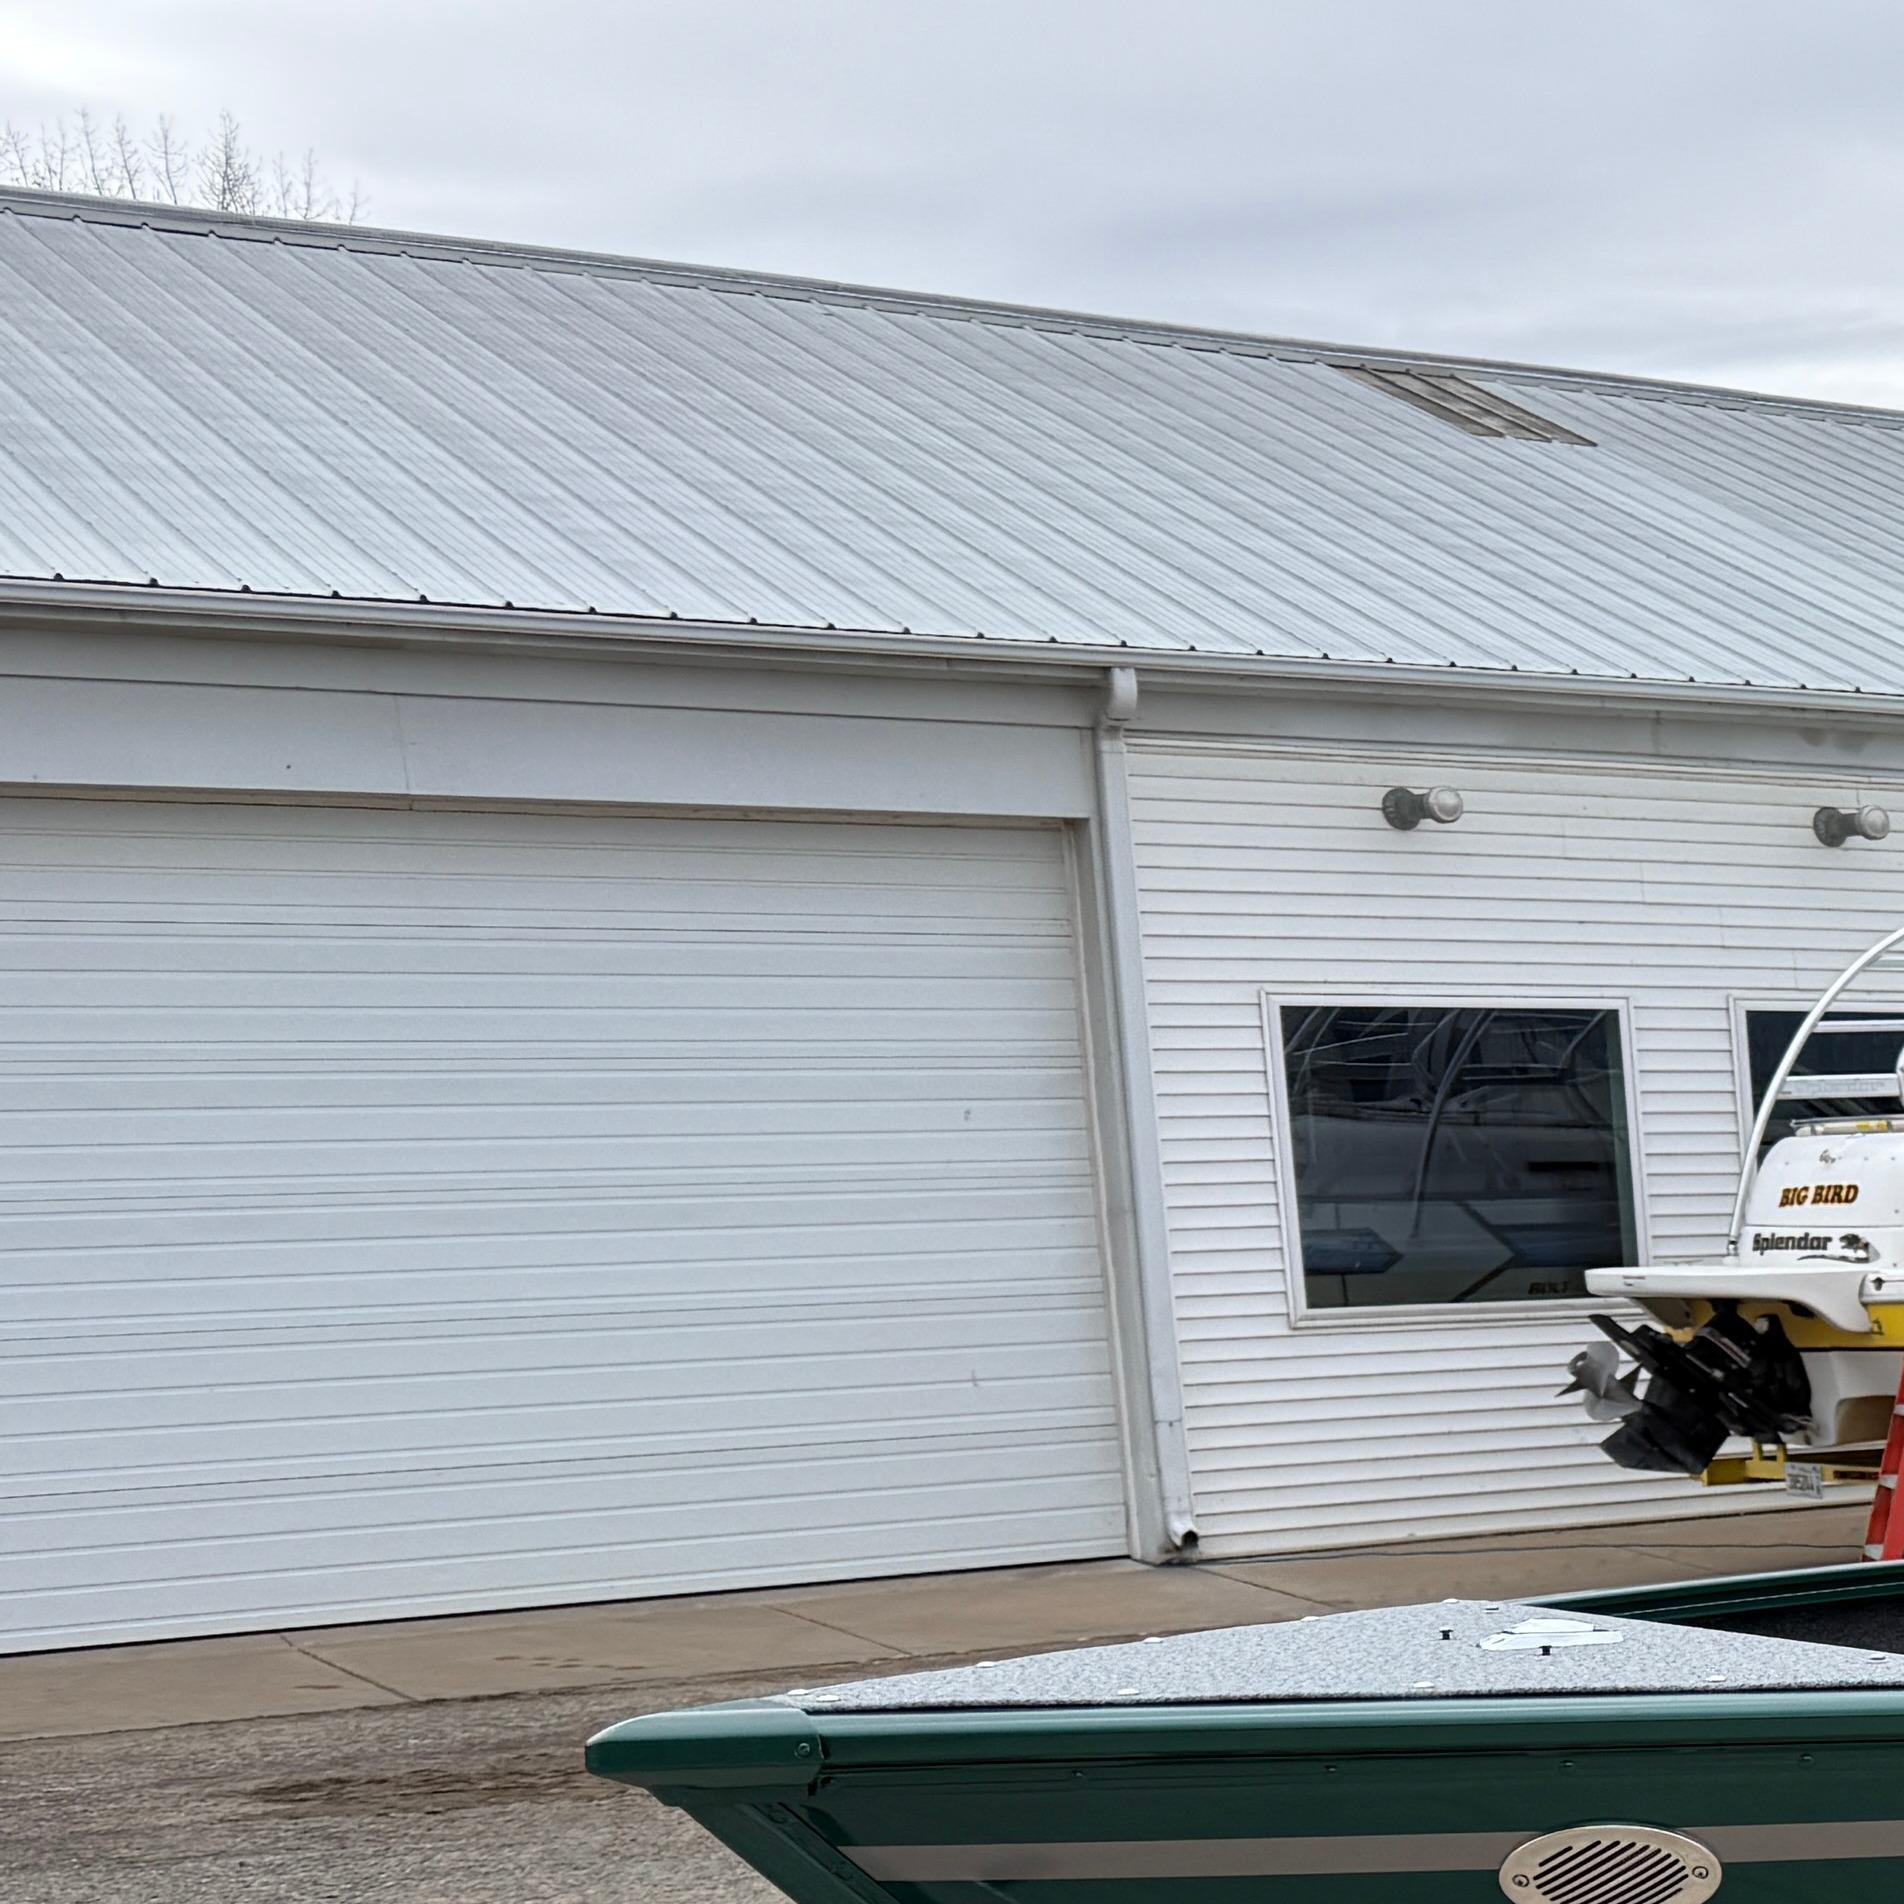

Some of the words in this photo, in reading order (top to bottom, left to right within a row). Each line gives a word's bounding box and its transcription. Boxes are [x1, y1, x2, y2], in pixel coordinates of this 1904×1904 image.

[1778, 1186, 1809, 1207] BIG
[1811, 1184, 1859, 1205] BIRD
[1752, 1232, 1833, 1255] Splendor
